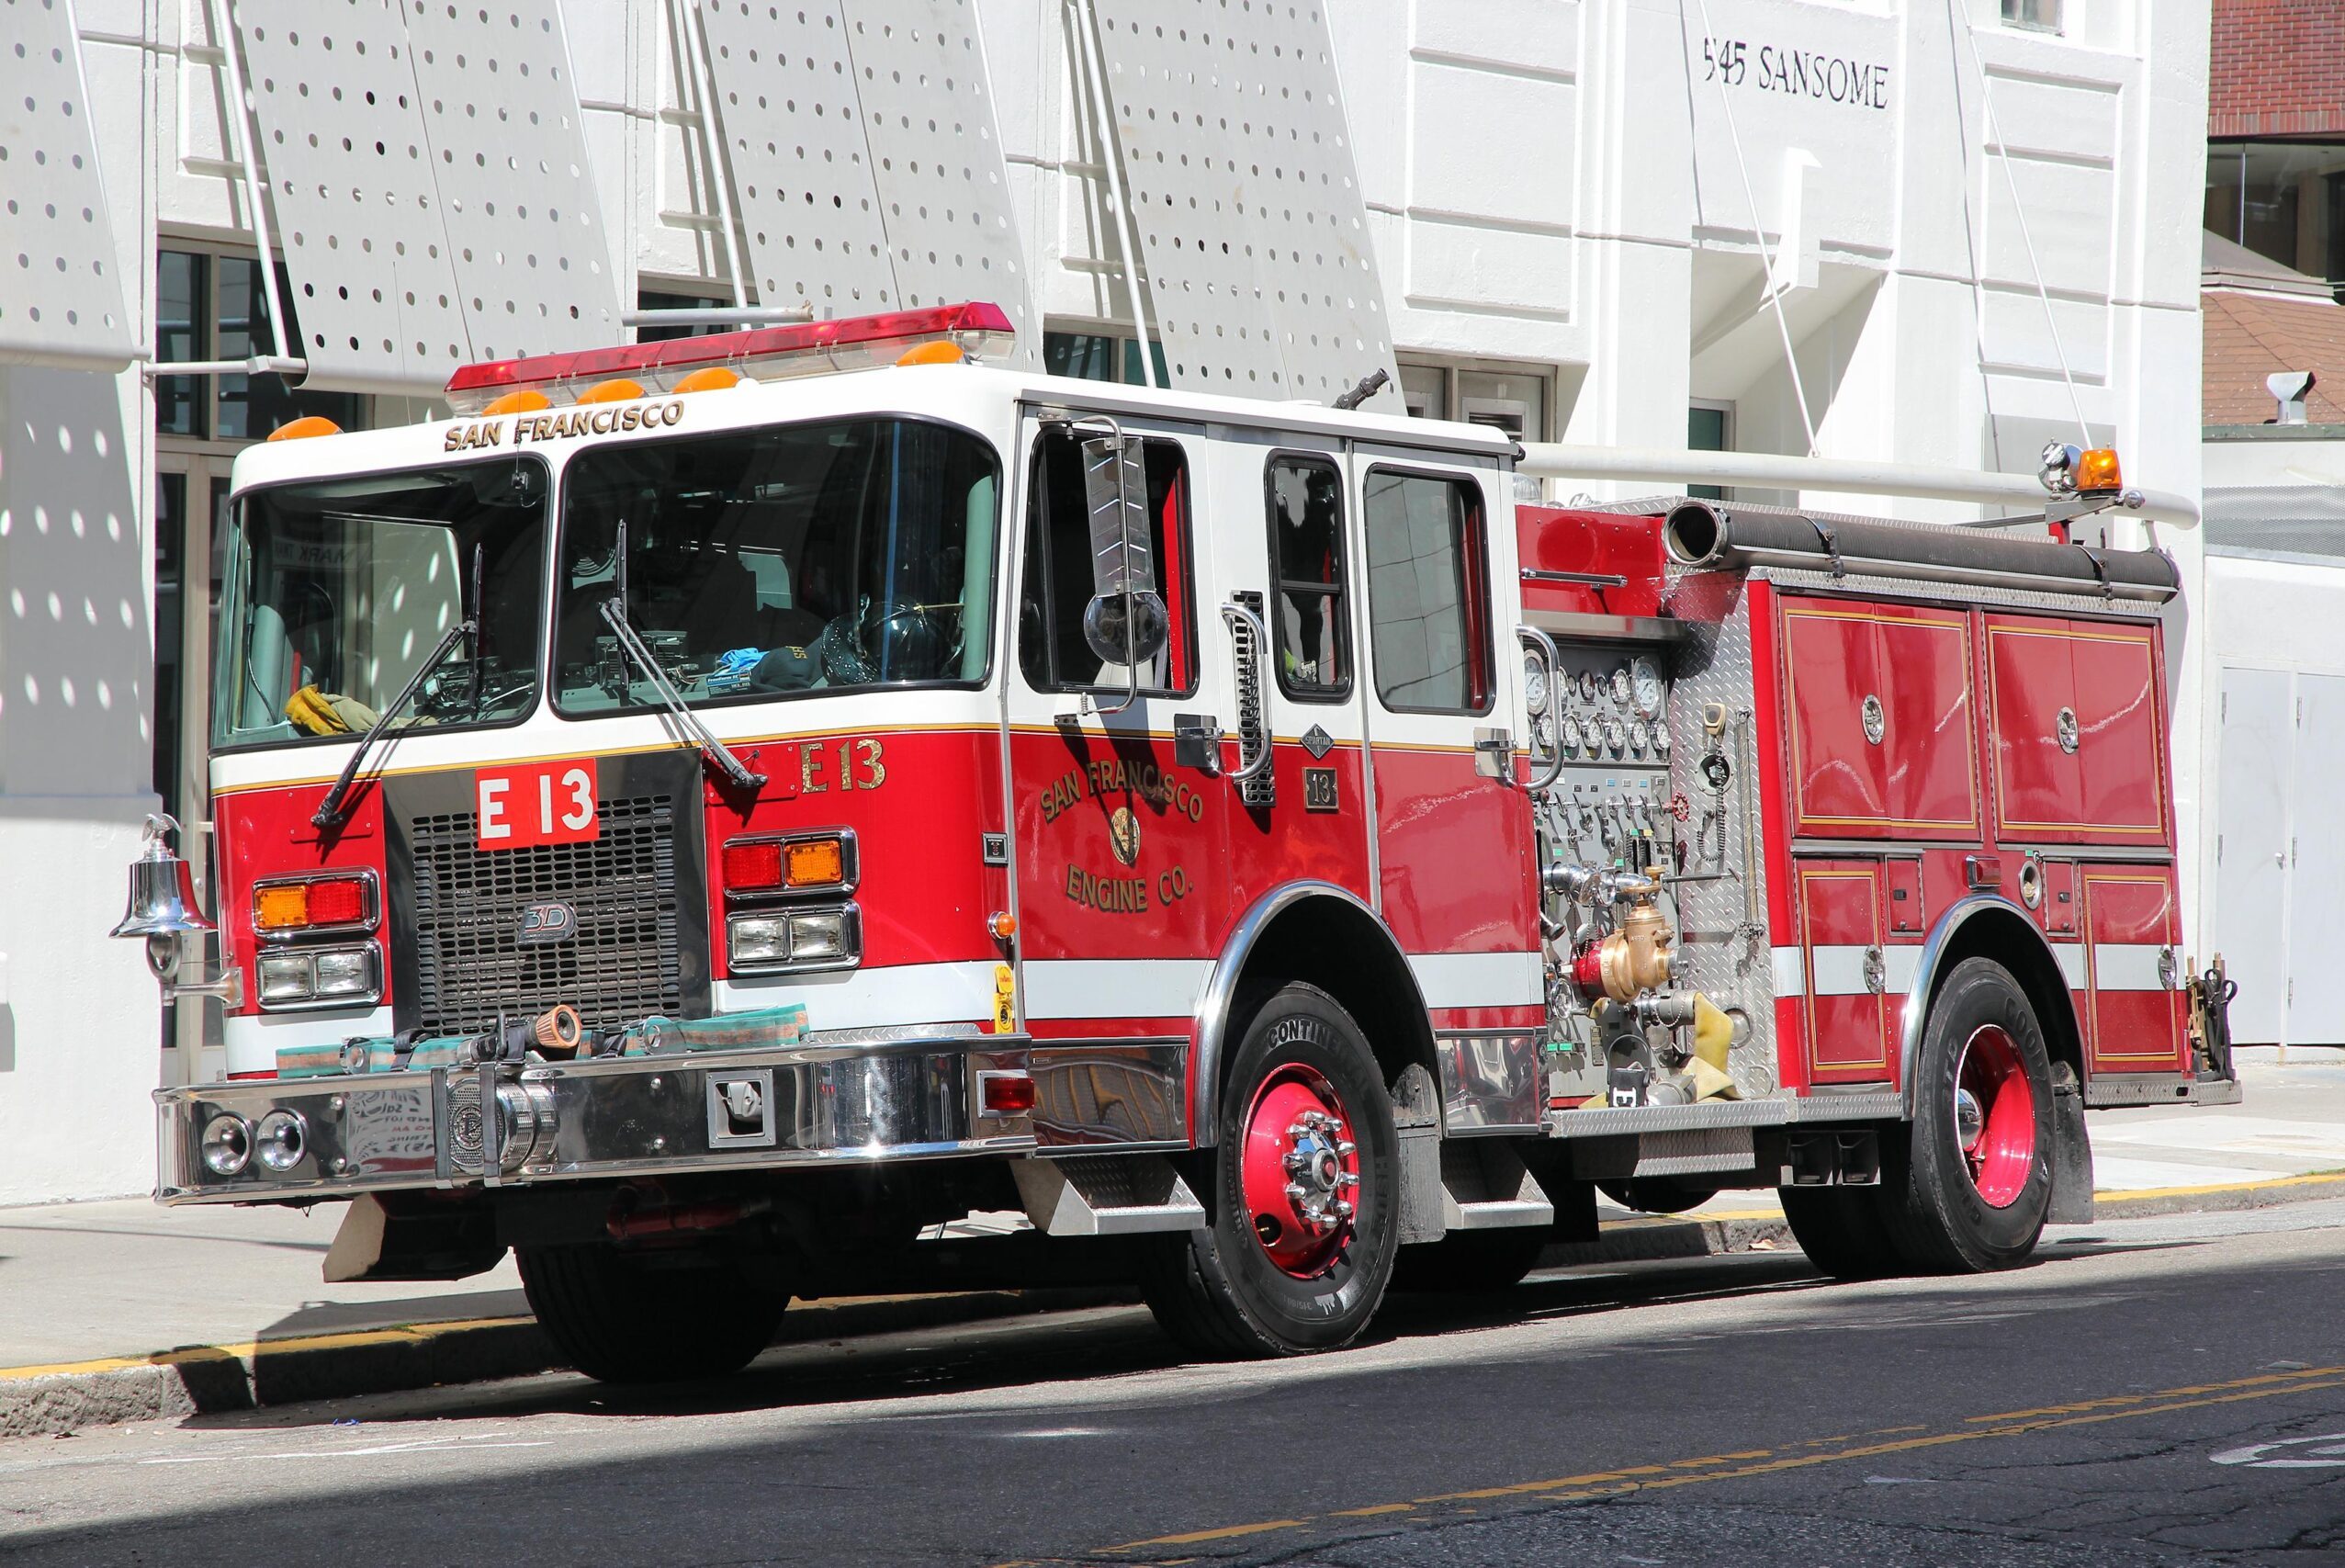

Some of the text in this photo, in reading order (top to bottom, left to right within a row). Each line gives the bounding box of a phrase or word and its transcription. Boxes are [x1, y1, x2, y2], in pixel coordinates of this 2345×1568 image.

[1705, 37, 1888, 109] 545 SANSOME
[445, 400, 685, 452] SAN FRANCISCO
[799, 739, 886, 795] E 13
[1304, 736, 1330, 746] SPARTAN
[479, 768, 594, 840] E 13
[1040, 759, 1204, 824] SAN FRANCISCO
[1312, 773, 1331, 804] 13
[1065, 863, 1193, 913] ENGINE CO.
[524, 905, 569, 932] 3D
